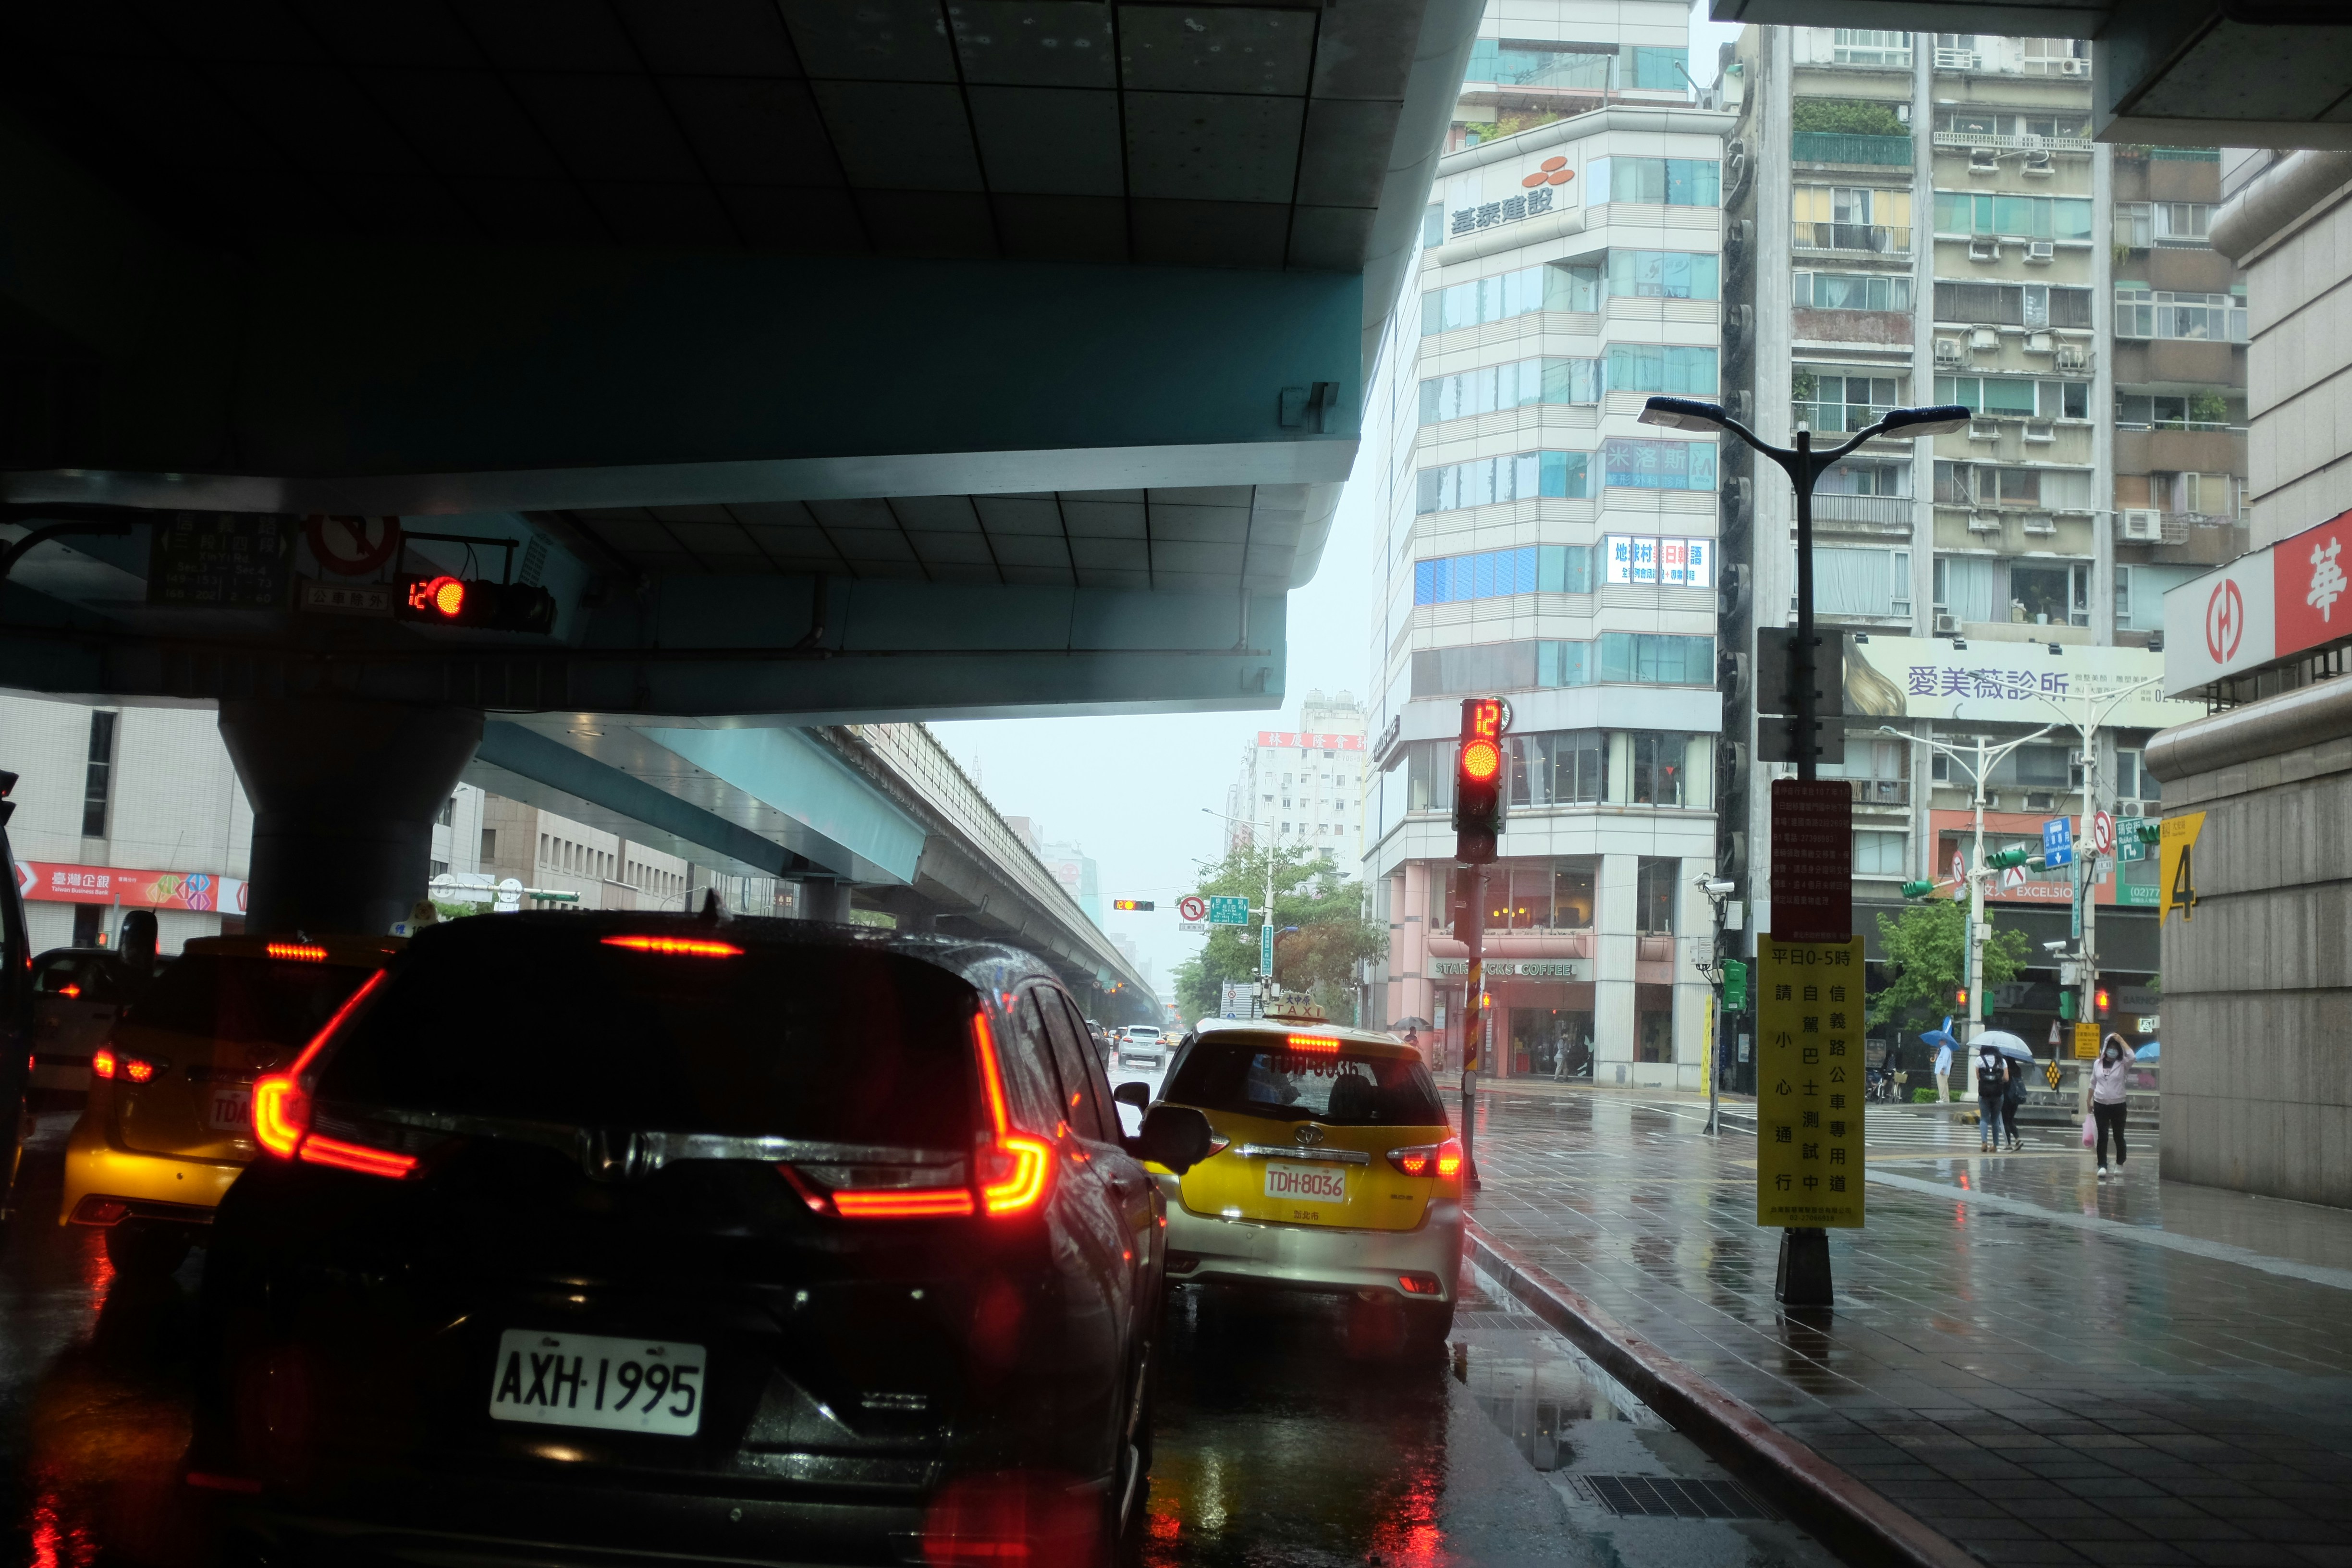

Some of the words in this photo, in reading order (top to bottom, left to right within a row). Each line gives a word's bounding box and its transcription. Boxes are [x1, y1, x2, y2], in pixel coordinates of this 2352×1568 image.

[1451, 187, 1553, 234] 基泰建設
[1607, 446, 1687, 470] 米洛斯
[1606, 474, 1687, 489] 整形外科診所
[2307, 537, 2347, 623] 華
[314, 589, 383, 608] 公車除外
[408, 581, 427, 611] 12
[1909, 666, 2070, 702] 愛美薇診所
[1476, 705, 1497, 735] 12
[51, 872, 110, 888] 臺灣企銀
[2172, 844, 2194, 919] 4
[1117, 901, 1123, 909] 12
[1521, 964, 1571, 976] COFFEE
[1772, 948, 1851, 967] 平日0-5時
[1275, 1004, 1321, 1017] TAXI
[1286, 994, 1311, 1006] 大中原
[1775, 984, 1792, 1191] 請小心通行
[1802, 985, 1819, 1192] 自駕巴士測試中
[1829, 985, 1846, 1193] 信義路公車專用道
[1268, 1171, 1343, 1197] TDH-8036
[1294, 1210, 1319, 1221] 新北市
[496, 1351, 699, 1418] AXH-1995
